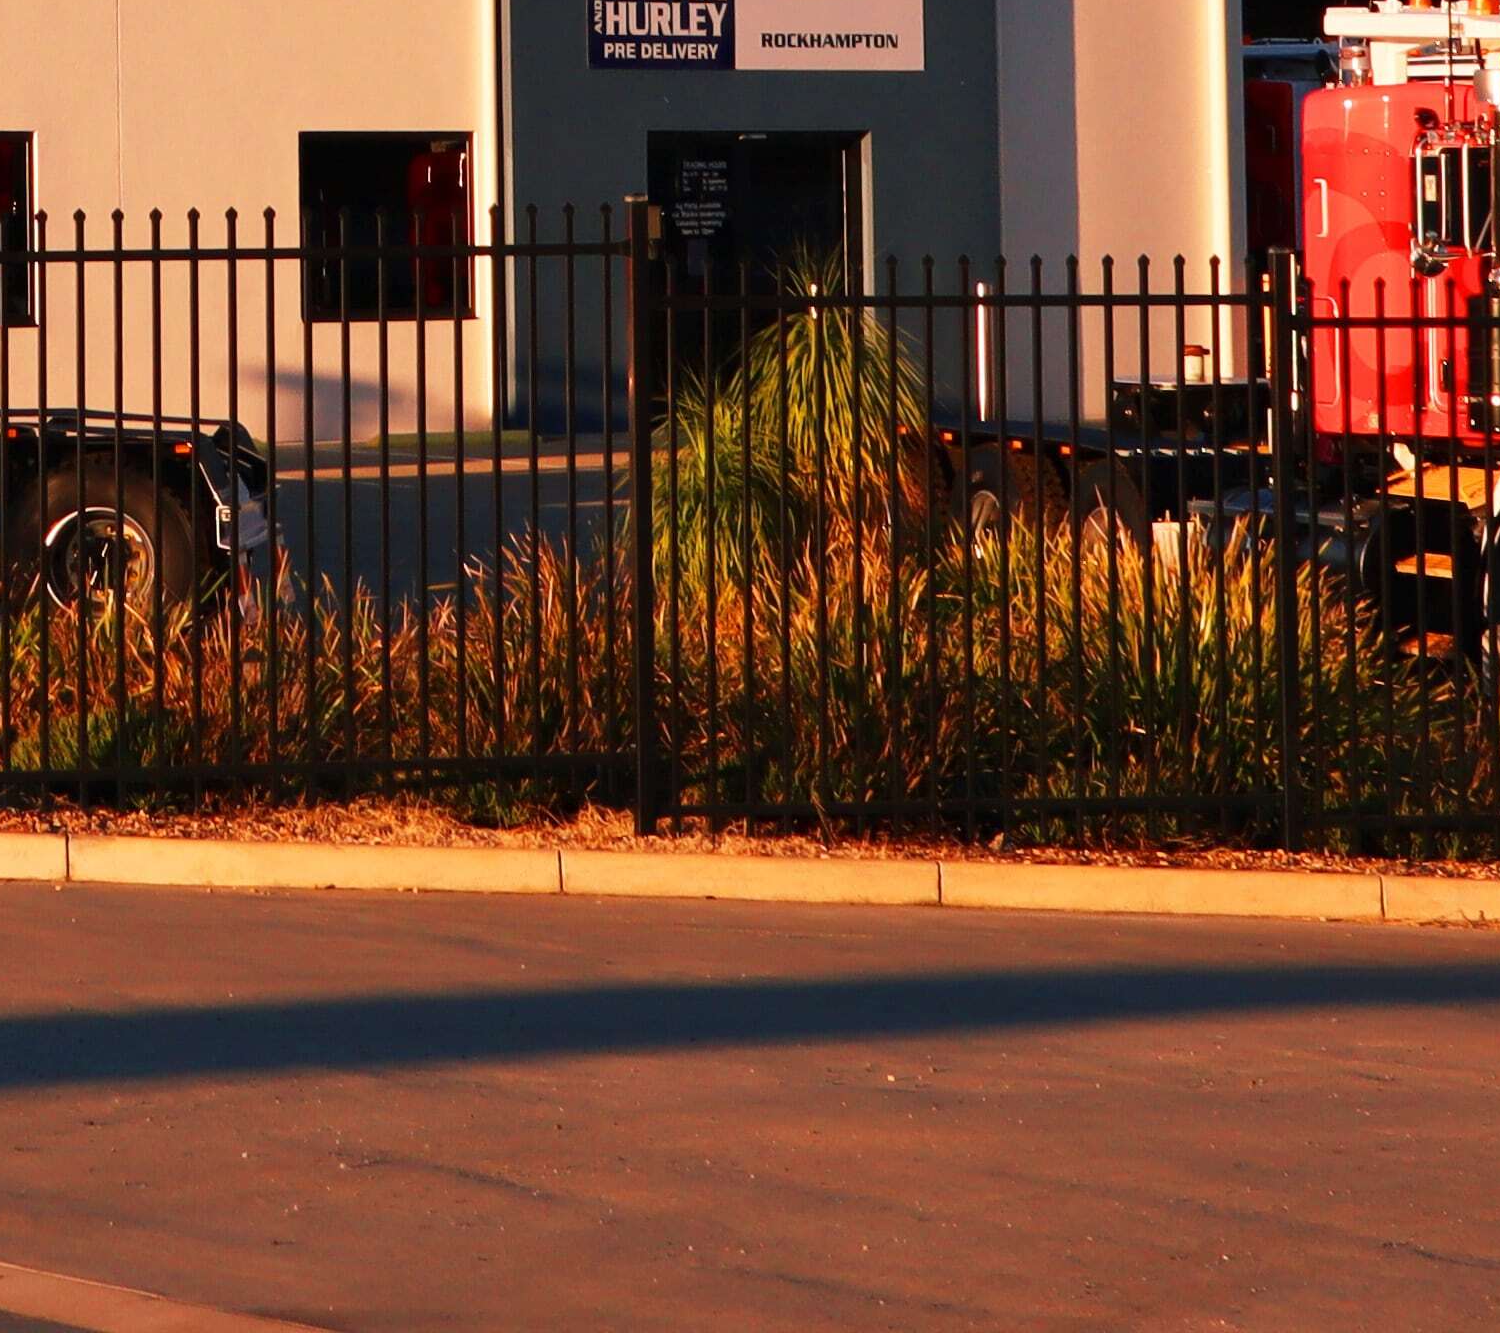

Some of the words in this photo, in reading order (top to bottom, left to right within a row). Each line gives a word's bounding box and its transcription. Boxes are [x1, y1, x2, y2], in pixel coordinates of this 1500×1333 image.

[594, 0, 603, 34] AND
[605, 1, 728, 37] HURLEY
[603, 42, 637, 60] PRE
[641, 42, 719, 61] DELIVERY
[760, 32, 899, 49] ROCKHAMPTON
